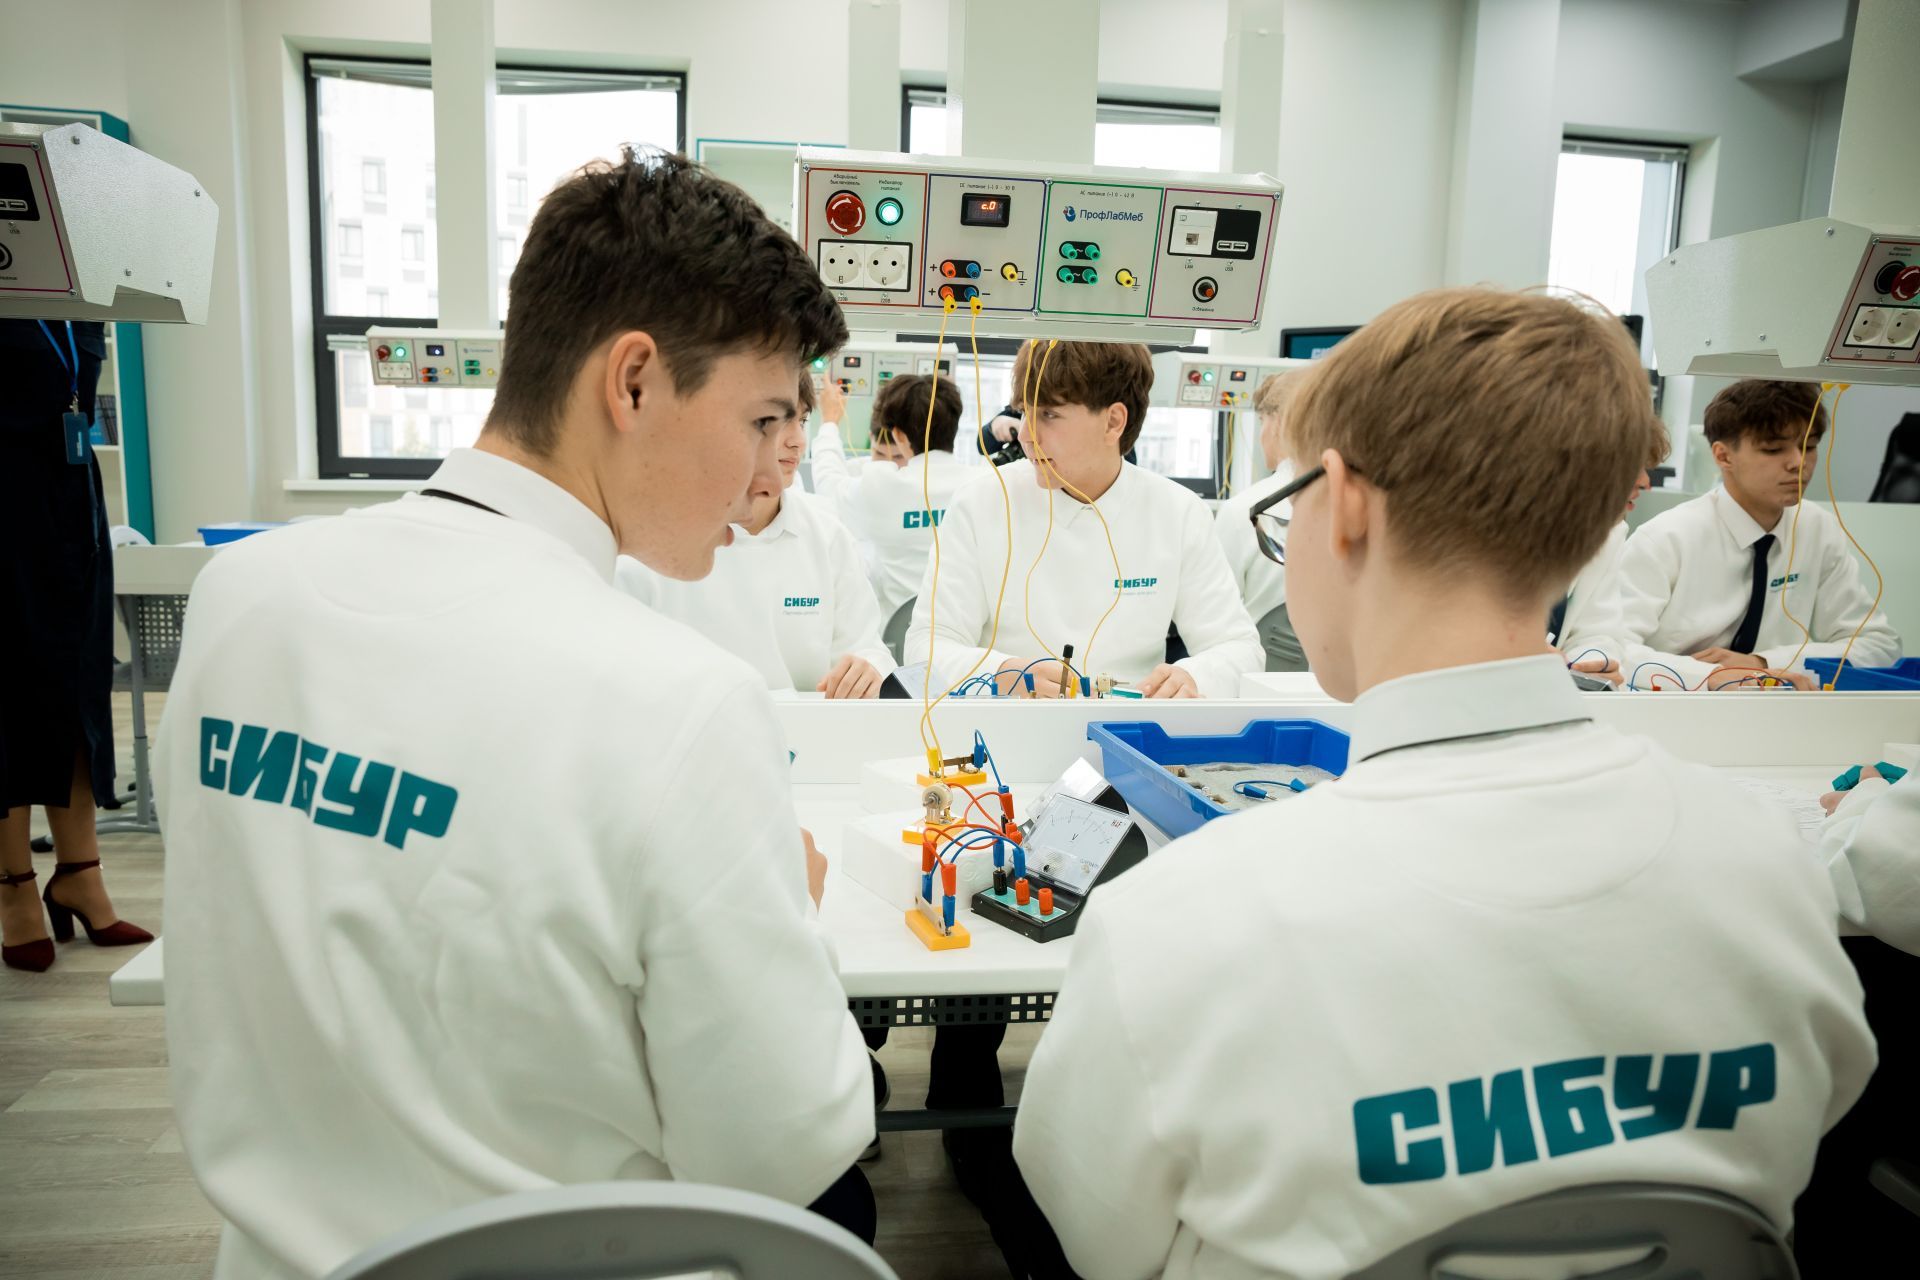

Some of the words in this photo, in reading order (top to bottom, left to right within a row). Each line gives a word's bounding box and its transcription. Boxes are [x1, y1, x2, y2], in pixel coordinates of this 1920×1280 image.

[1079, 209, 1144, 222] ПрофЛабМеб
[1114, 577, 1157, 589] СИБУР
[784, 597, 820, 607] СИБУР
[200, 716, 459, 851] СИБУР
[1353, 1042, 1777, 1186] СИБУР
